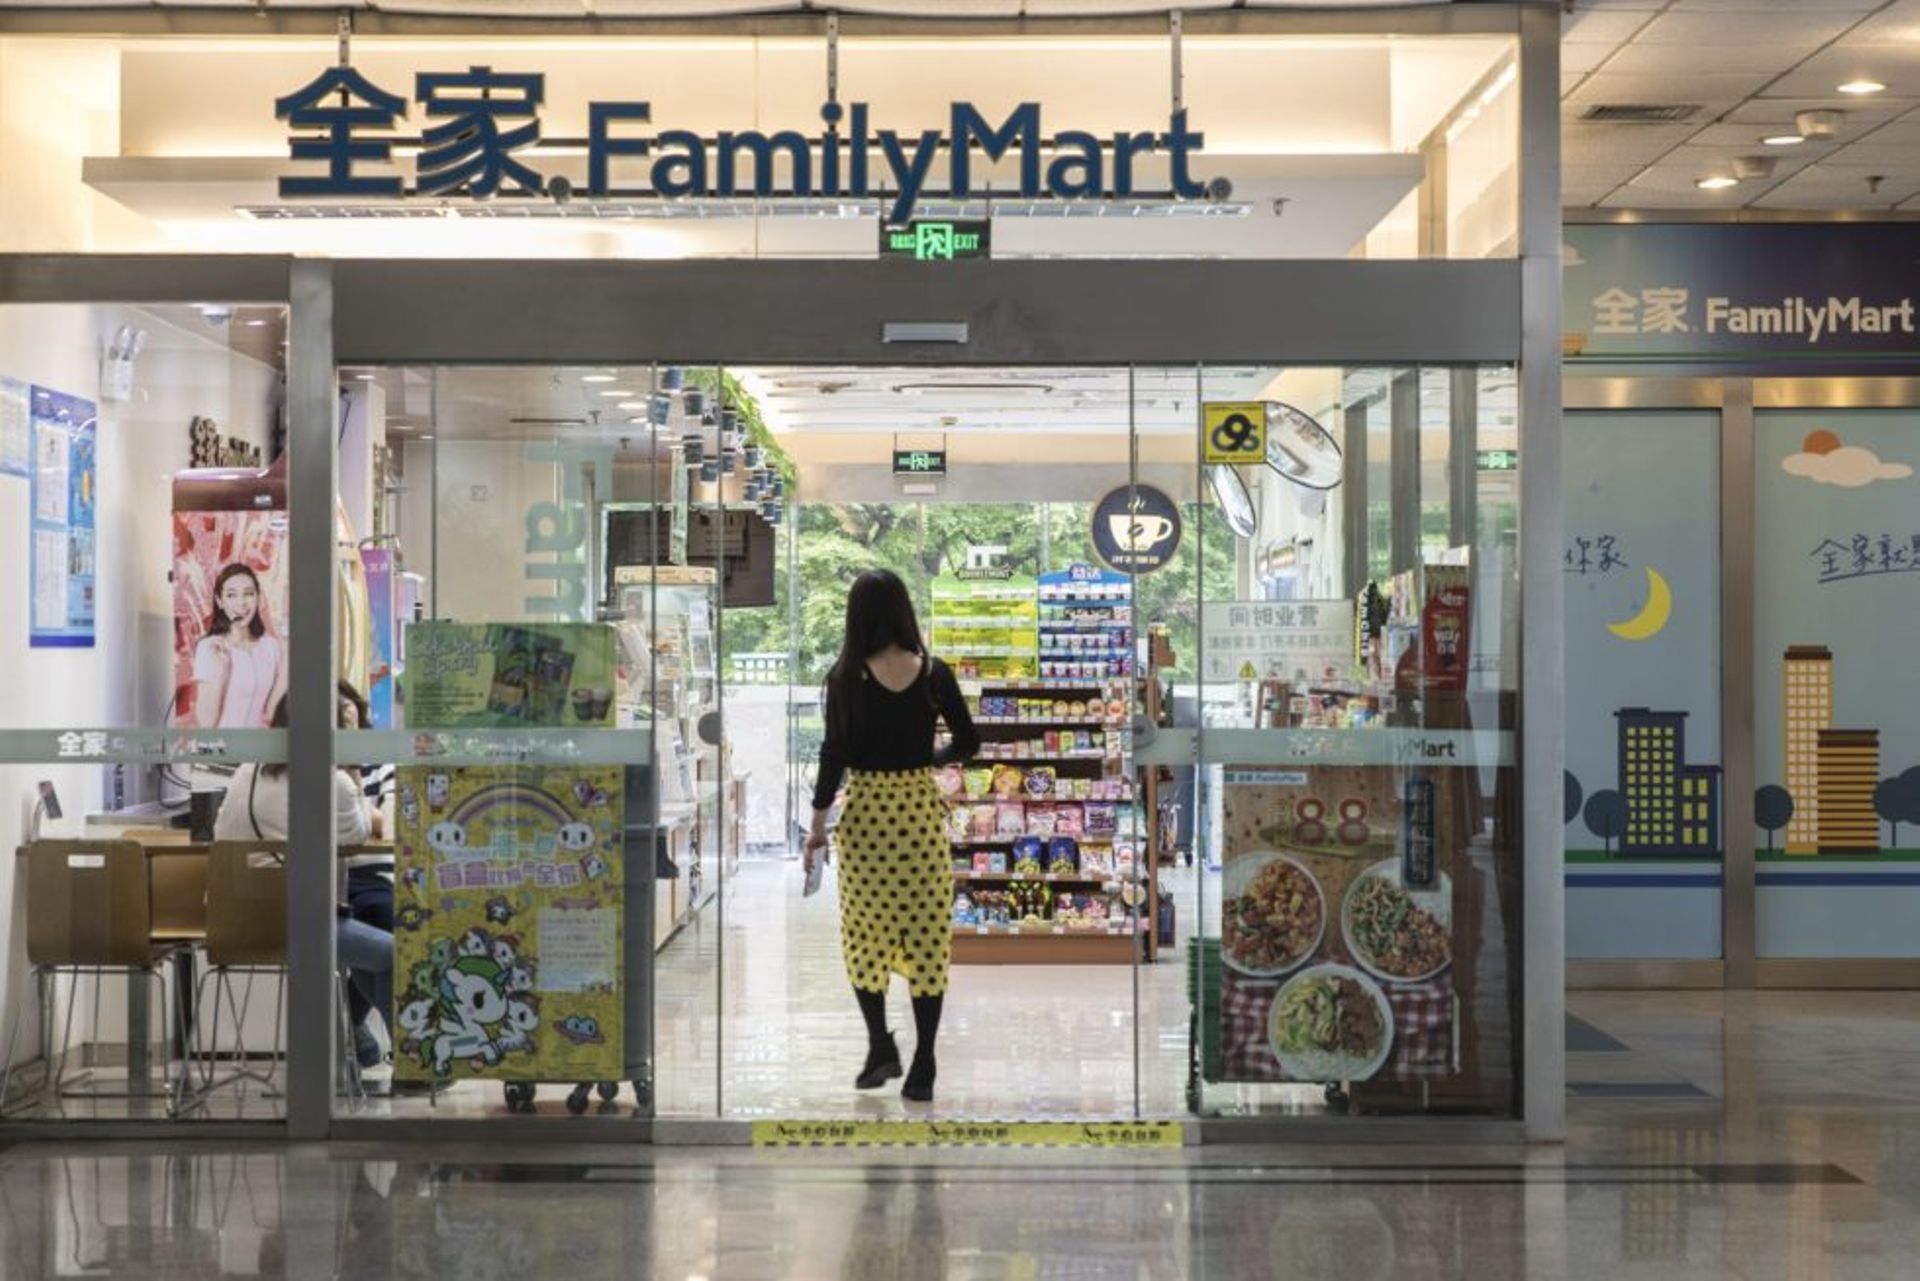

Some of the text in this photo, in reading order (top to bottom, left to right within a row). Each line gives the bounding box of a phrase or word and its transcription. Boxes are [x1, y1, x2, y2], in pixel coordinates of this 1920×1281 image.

[275, 66, 1205, 226] 全家 FamilyMart
[954, 234, 979, 249] EXIT
[1592, 287, 1915, 343] 全家 FamilyMart
